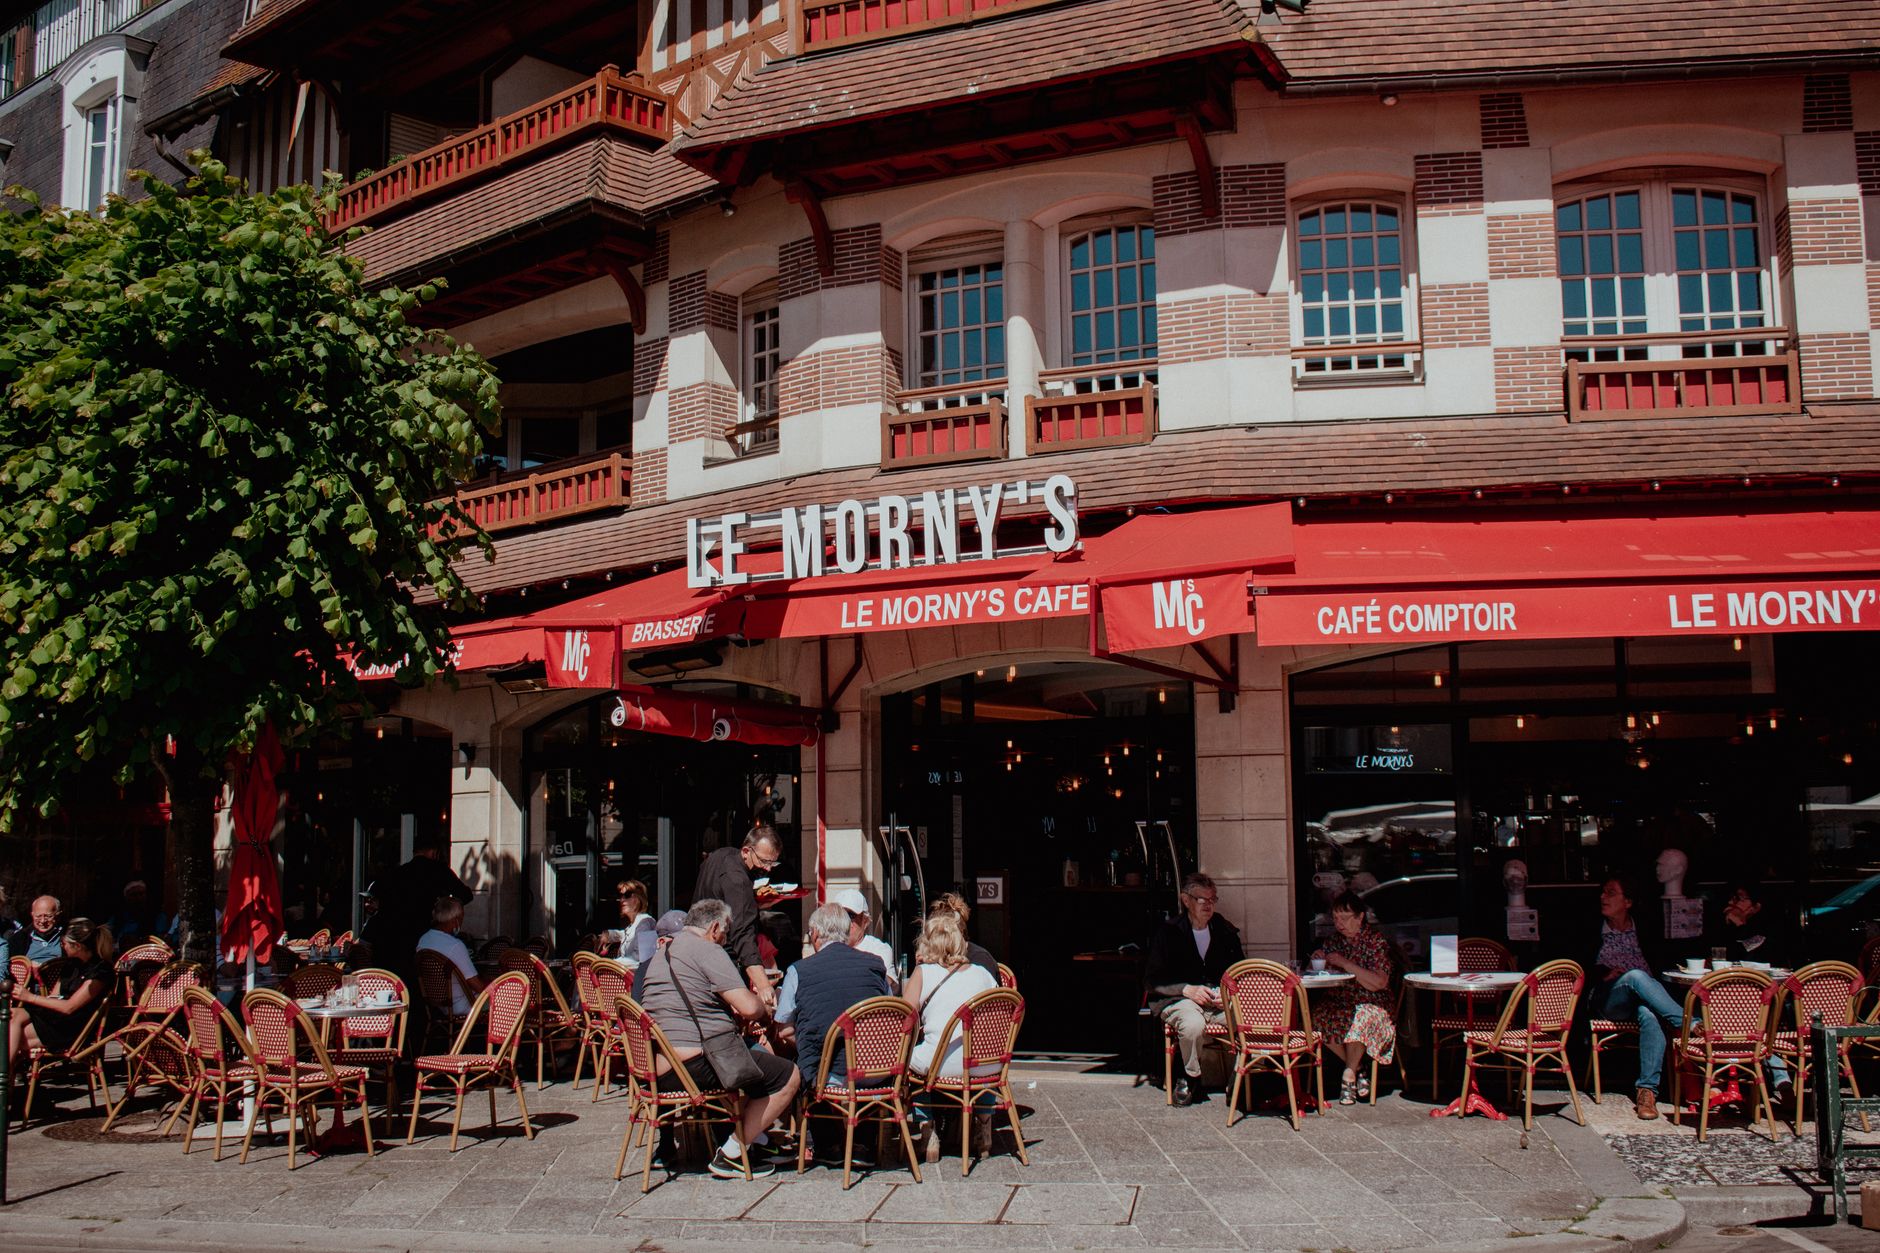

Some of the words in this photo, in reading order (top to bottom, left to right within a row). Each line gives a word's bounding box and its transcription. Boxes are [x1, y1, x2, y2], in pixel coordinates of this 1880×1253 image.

[687, 512, 748, 588] LE
[782, 474, 1078, 580] MORNY'S
[841, 600, 873, 628] LE
[881, 588, 1005, 626] MORNY'S
[1317, 598, 1382, 634] CAFÉ
[1388, 602, 1517, 632] COMPTOIR
[1669, 593, 1717, 628] LE
[1727, 589, 1880, 626] MORNY'
[631, 613, 716, 643] BRASSERIE
[1356, 755, 1368, 768] LE
